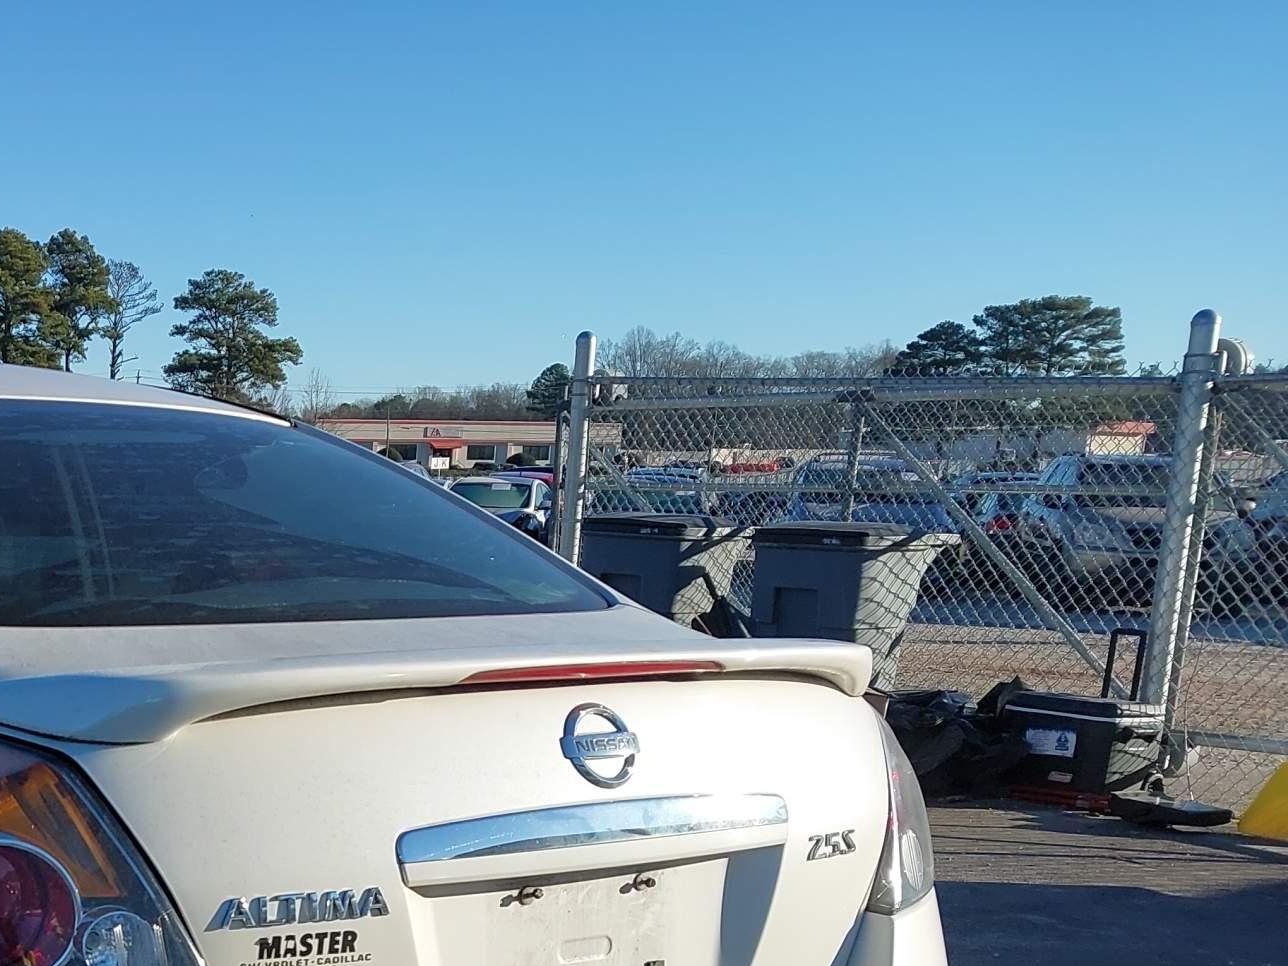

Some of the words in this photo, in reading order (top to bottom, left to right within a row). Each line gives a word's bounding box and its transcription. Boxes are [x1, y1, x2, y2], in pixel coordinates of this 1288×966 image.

[575, 735, 638, 753] NISSAN
[203, 886, 391, 932] ALTIMA
[254, 930, 358, 960] MASTER
